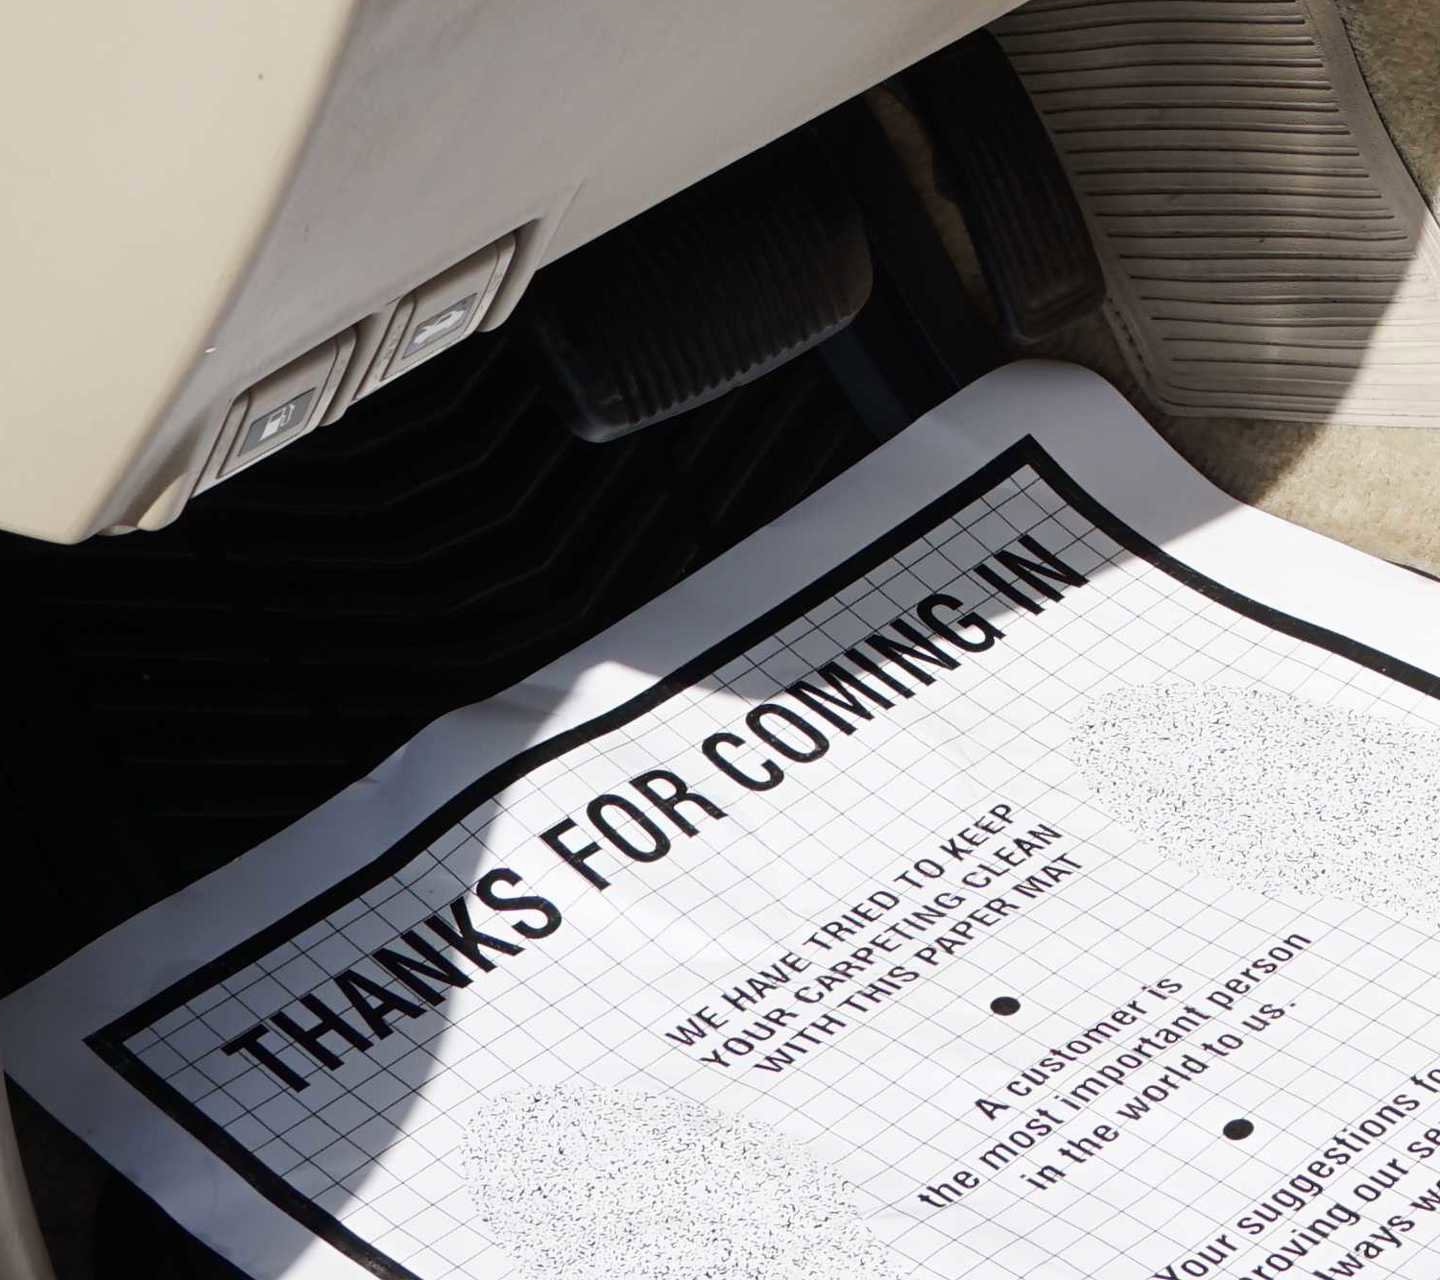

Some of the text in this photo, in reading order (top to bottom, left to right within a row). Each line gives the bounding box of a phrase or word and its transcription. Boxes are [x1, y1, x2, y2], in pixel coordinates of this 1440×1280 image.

[221, 533, 1091, 1093] THANKS FOR COMING IN
[664, 802, 1015, 1048] WE HAVE TRIED TO KEEP
[699, 822, 1063, 1070] YOUR CARPETING CLEAN
[753, 851, 1084, 1076] WITH THIS PAPER MAT
[917, 931, 1313, 1210] the most important person
[974, 977, 1185, 1121] A customer is
[1019, 1000, 1298, 1192] in the world to us.
[1152, 1233, 1240, 1280] Your
[1236, 1093, 1421, 1235] suggestions
[1238, 1202, 1361, 1280] roving
[1352, 1157, 1410, 1203] our
[1312, 1215, 1416, 1280] lways
